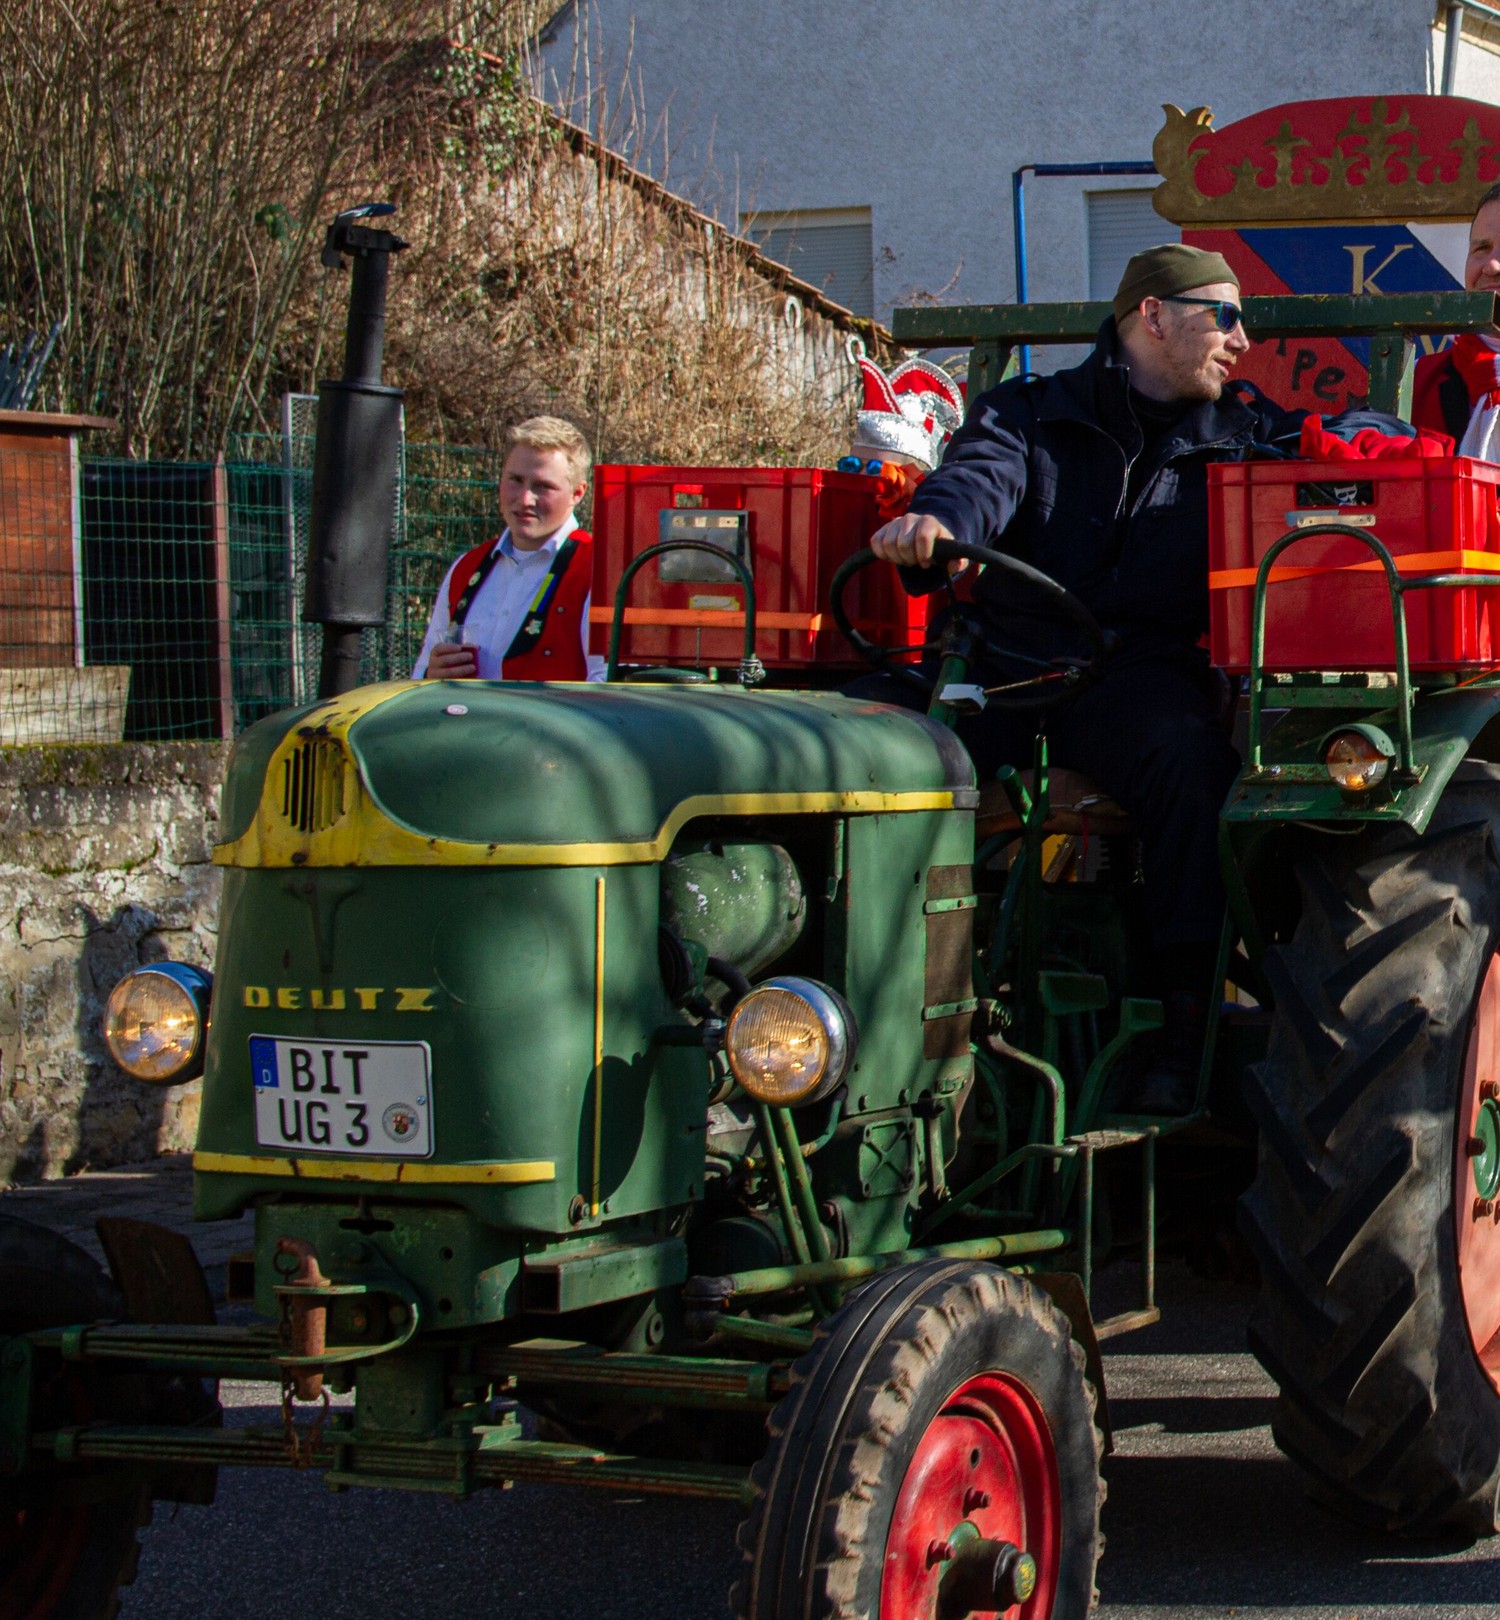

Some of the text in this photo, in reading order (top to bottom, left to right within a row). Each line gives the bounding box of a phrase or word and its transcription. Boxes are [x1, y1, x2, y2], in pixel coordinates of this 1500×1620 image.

[243, 986, 435, 1011] DEUTZ
[262, 1069, 272, 1084] D
[290, 1047, 368, 1094] BIT
[278, 1098, 369, 1146] UG 3
